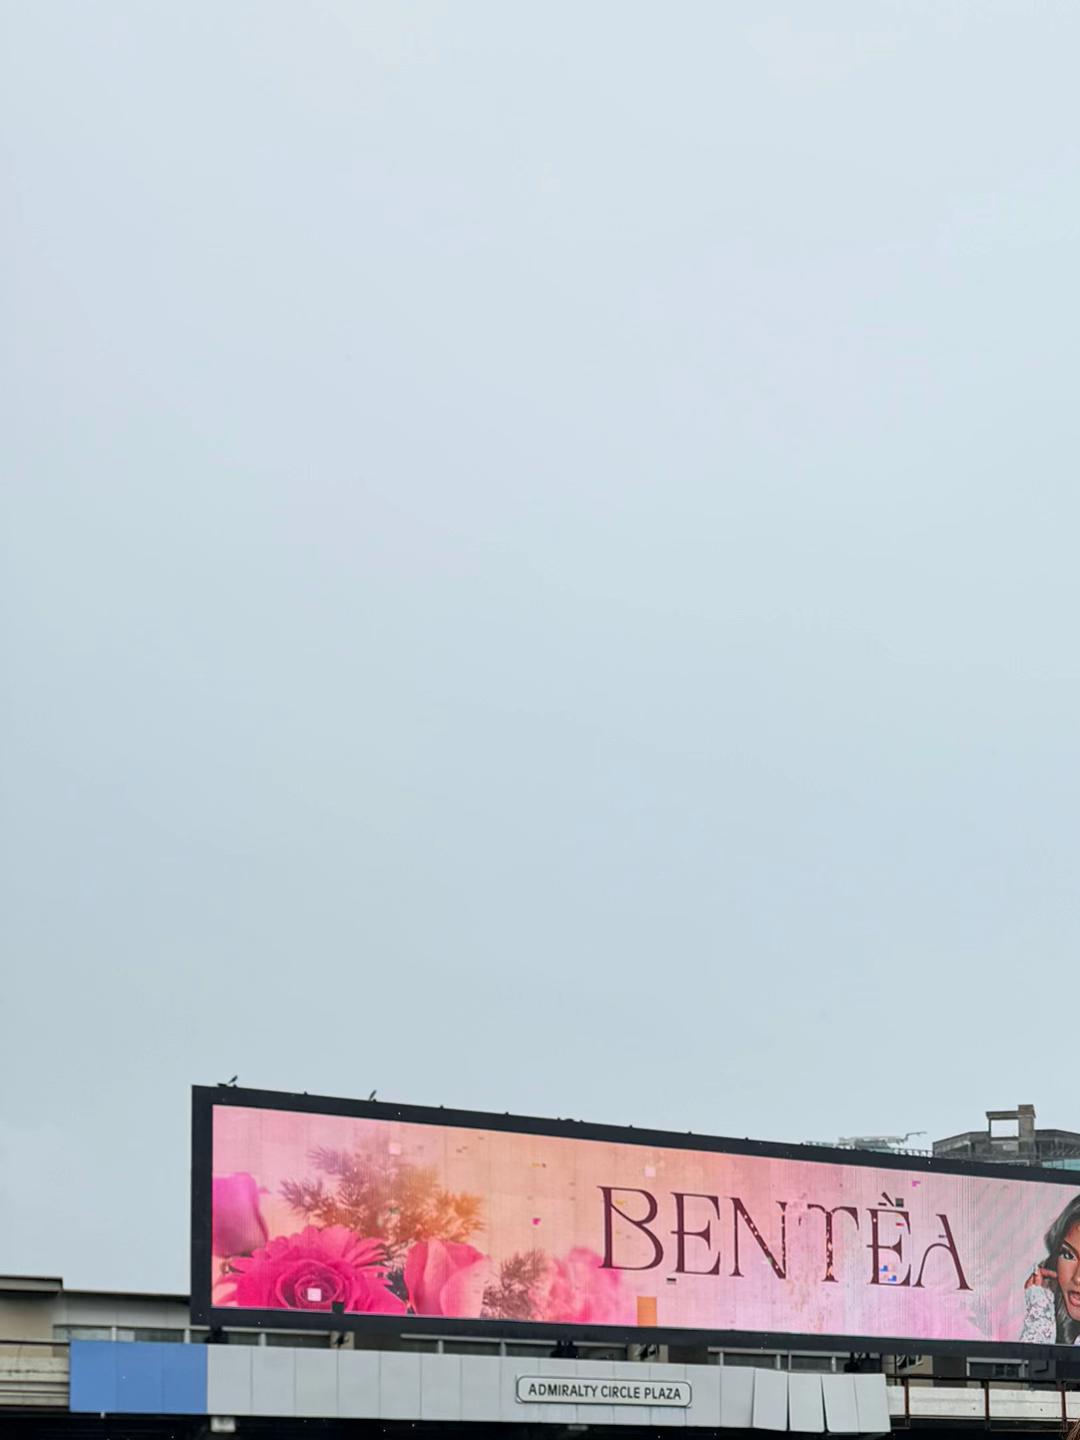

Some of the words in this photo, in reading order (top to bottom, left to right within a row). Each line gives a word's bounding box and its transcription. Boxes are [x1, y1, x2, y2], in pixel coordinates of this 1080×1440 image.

[528, 1383, 598, 1398] ADMIRALTY
[600, 1385, 640, 1399] CIRCLE
[644, 1387, 681, 1400] PLAZA
